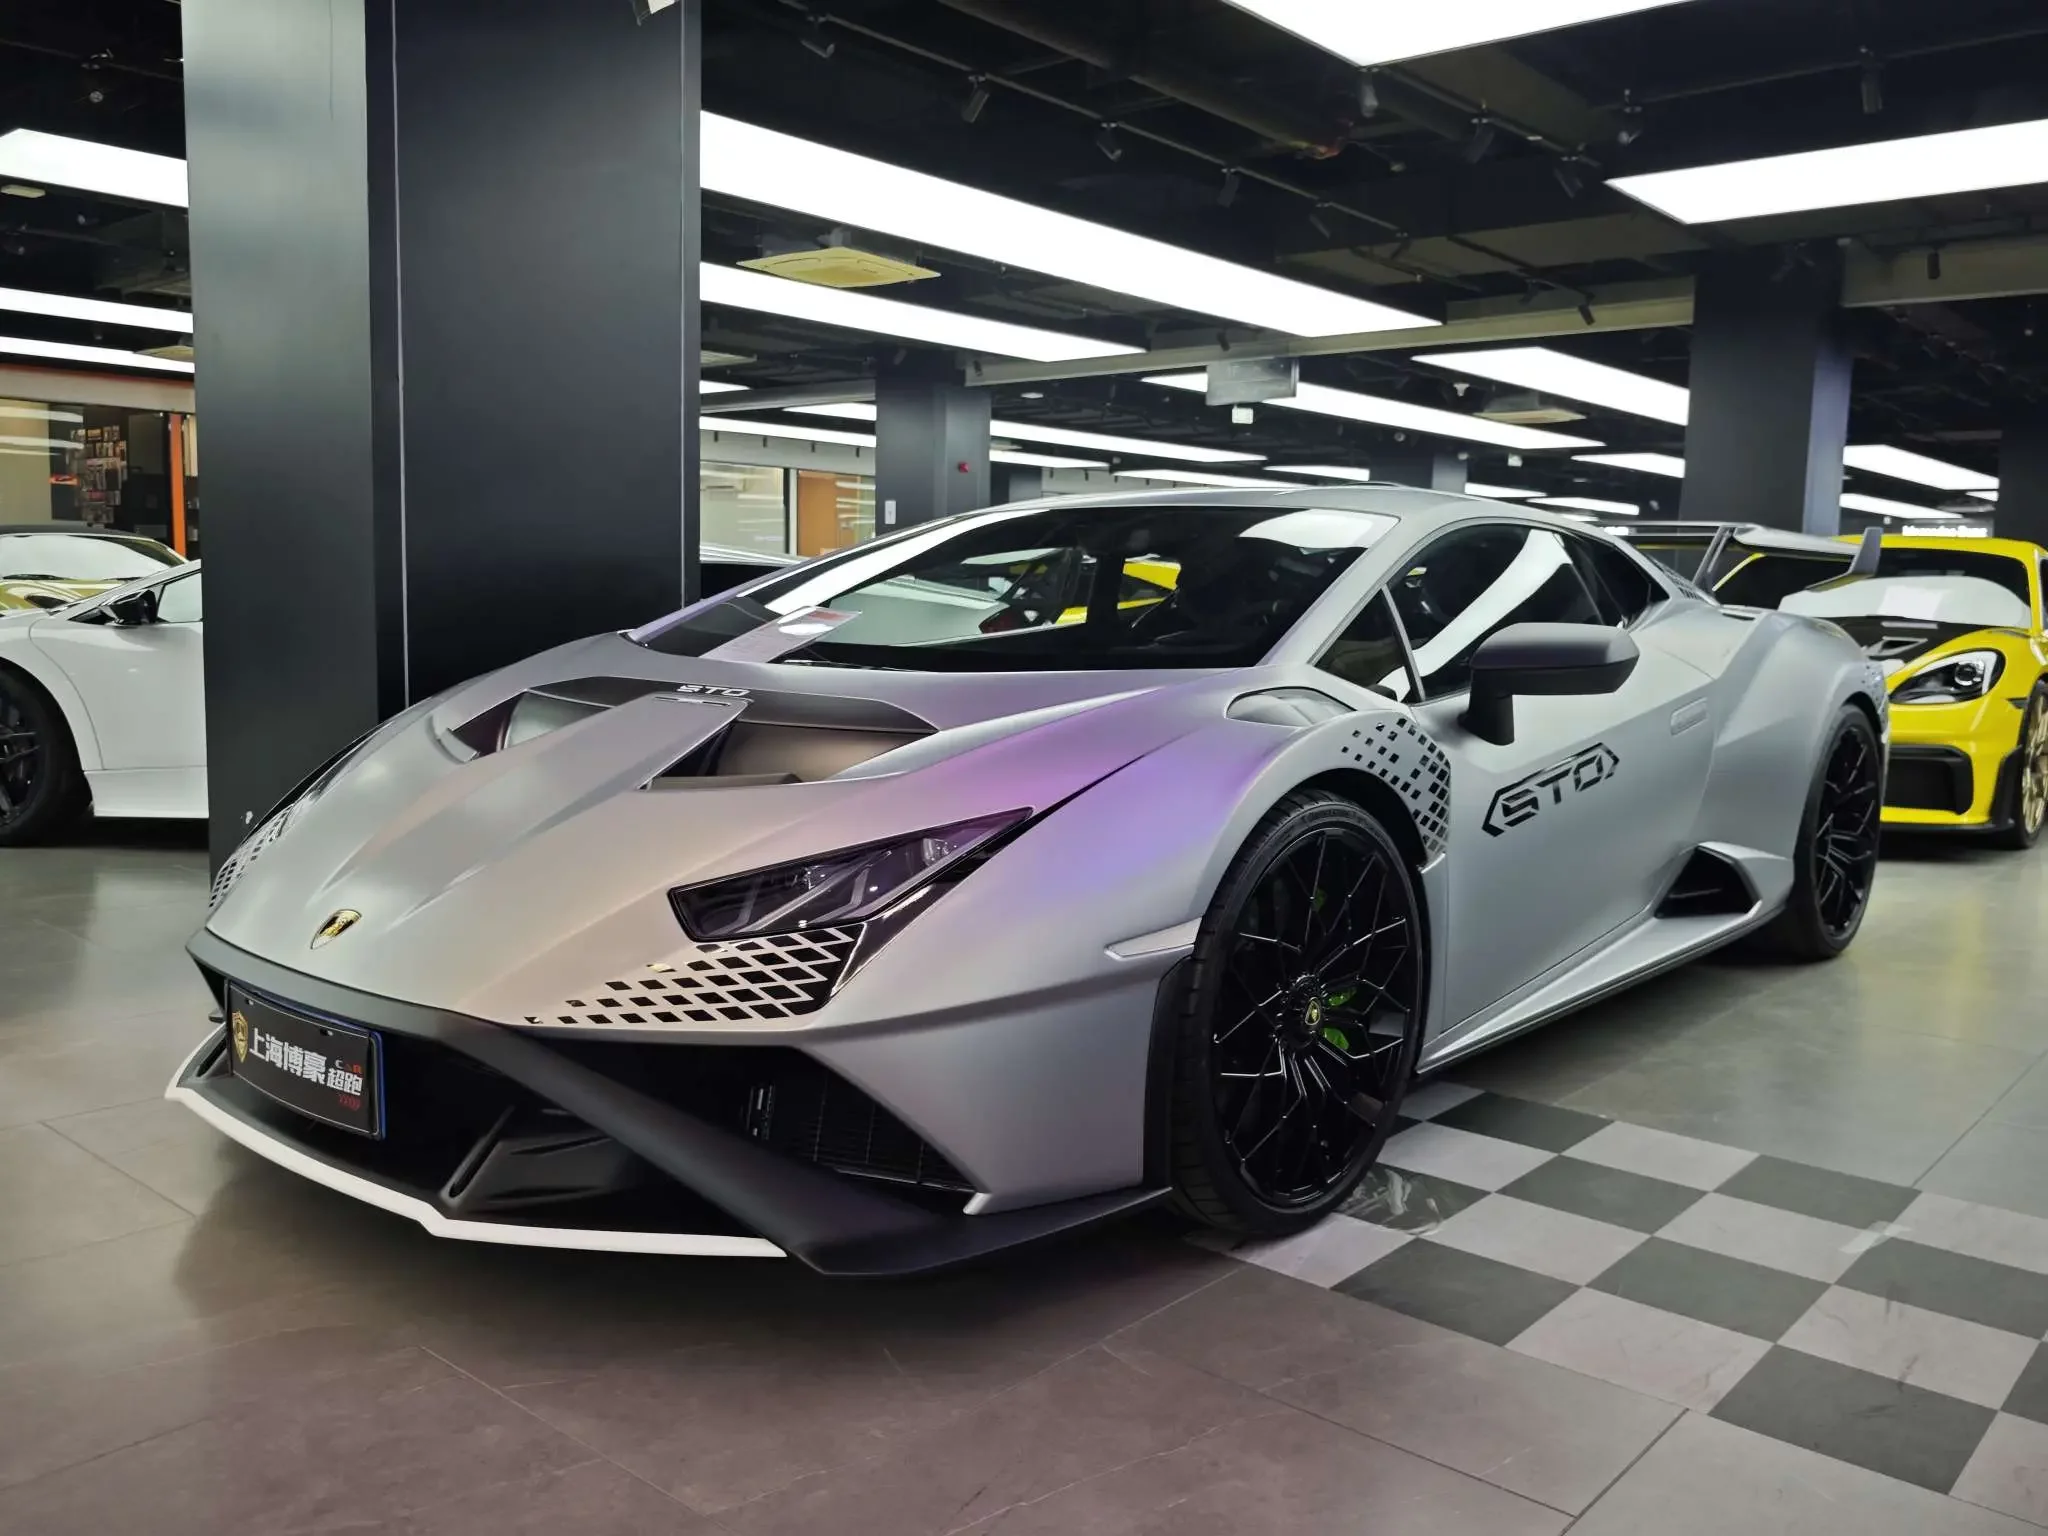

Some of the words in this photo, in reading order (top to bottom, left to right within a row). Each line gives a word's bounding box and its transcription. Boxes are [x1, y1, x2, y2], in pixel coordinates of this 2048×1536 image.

[676, 684, 751, 697] STO
[1501, 753, 1604, 828] STO
[249, 1027, 327, 1086] 上海博豪
[326, 1067, 364, 1096] 超跑
